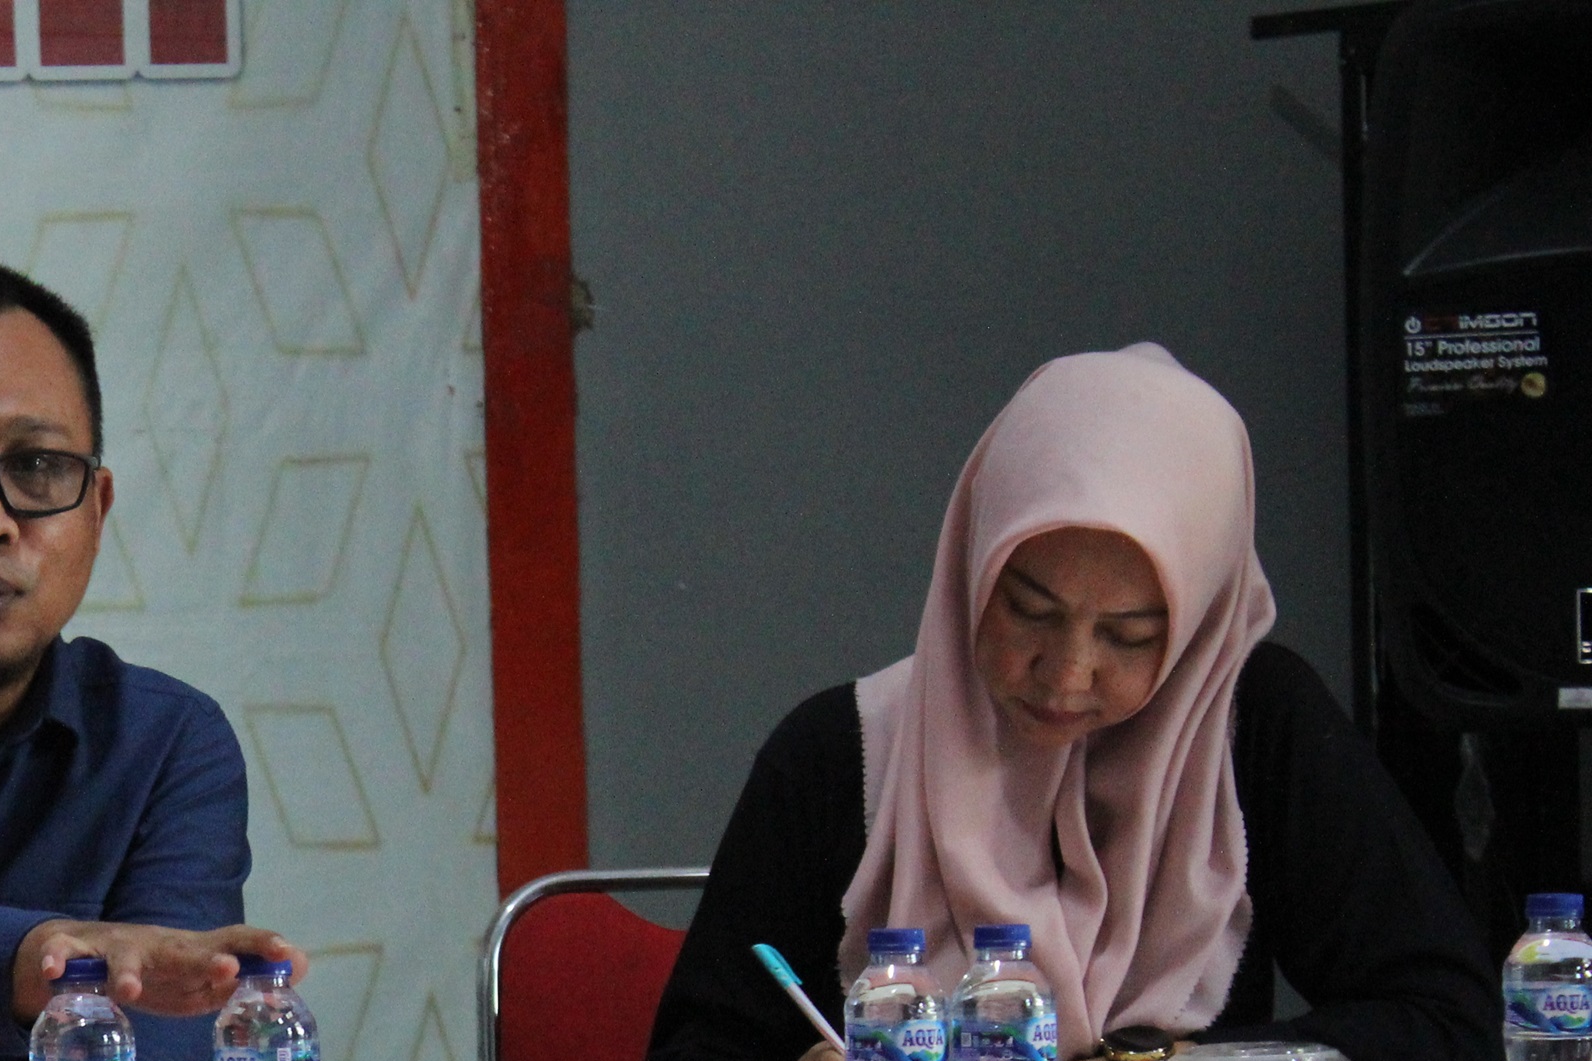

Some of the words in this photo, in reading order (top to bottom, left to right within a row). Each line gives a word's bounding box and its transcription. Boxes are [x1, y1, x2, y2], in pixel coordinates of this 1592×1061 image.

[1437, 337, 1541, 356] Professional
[1404, 358, 1495, 373] Loudspeaker
[1498, 355, 1549, 370] System
[1542, 993, 1591, 1014] AQUA
[902, 1028, 944, 1049] AQUA
